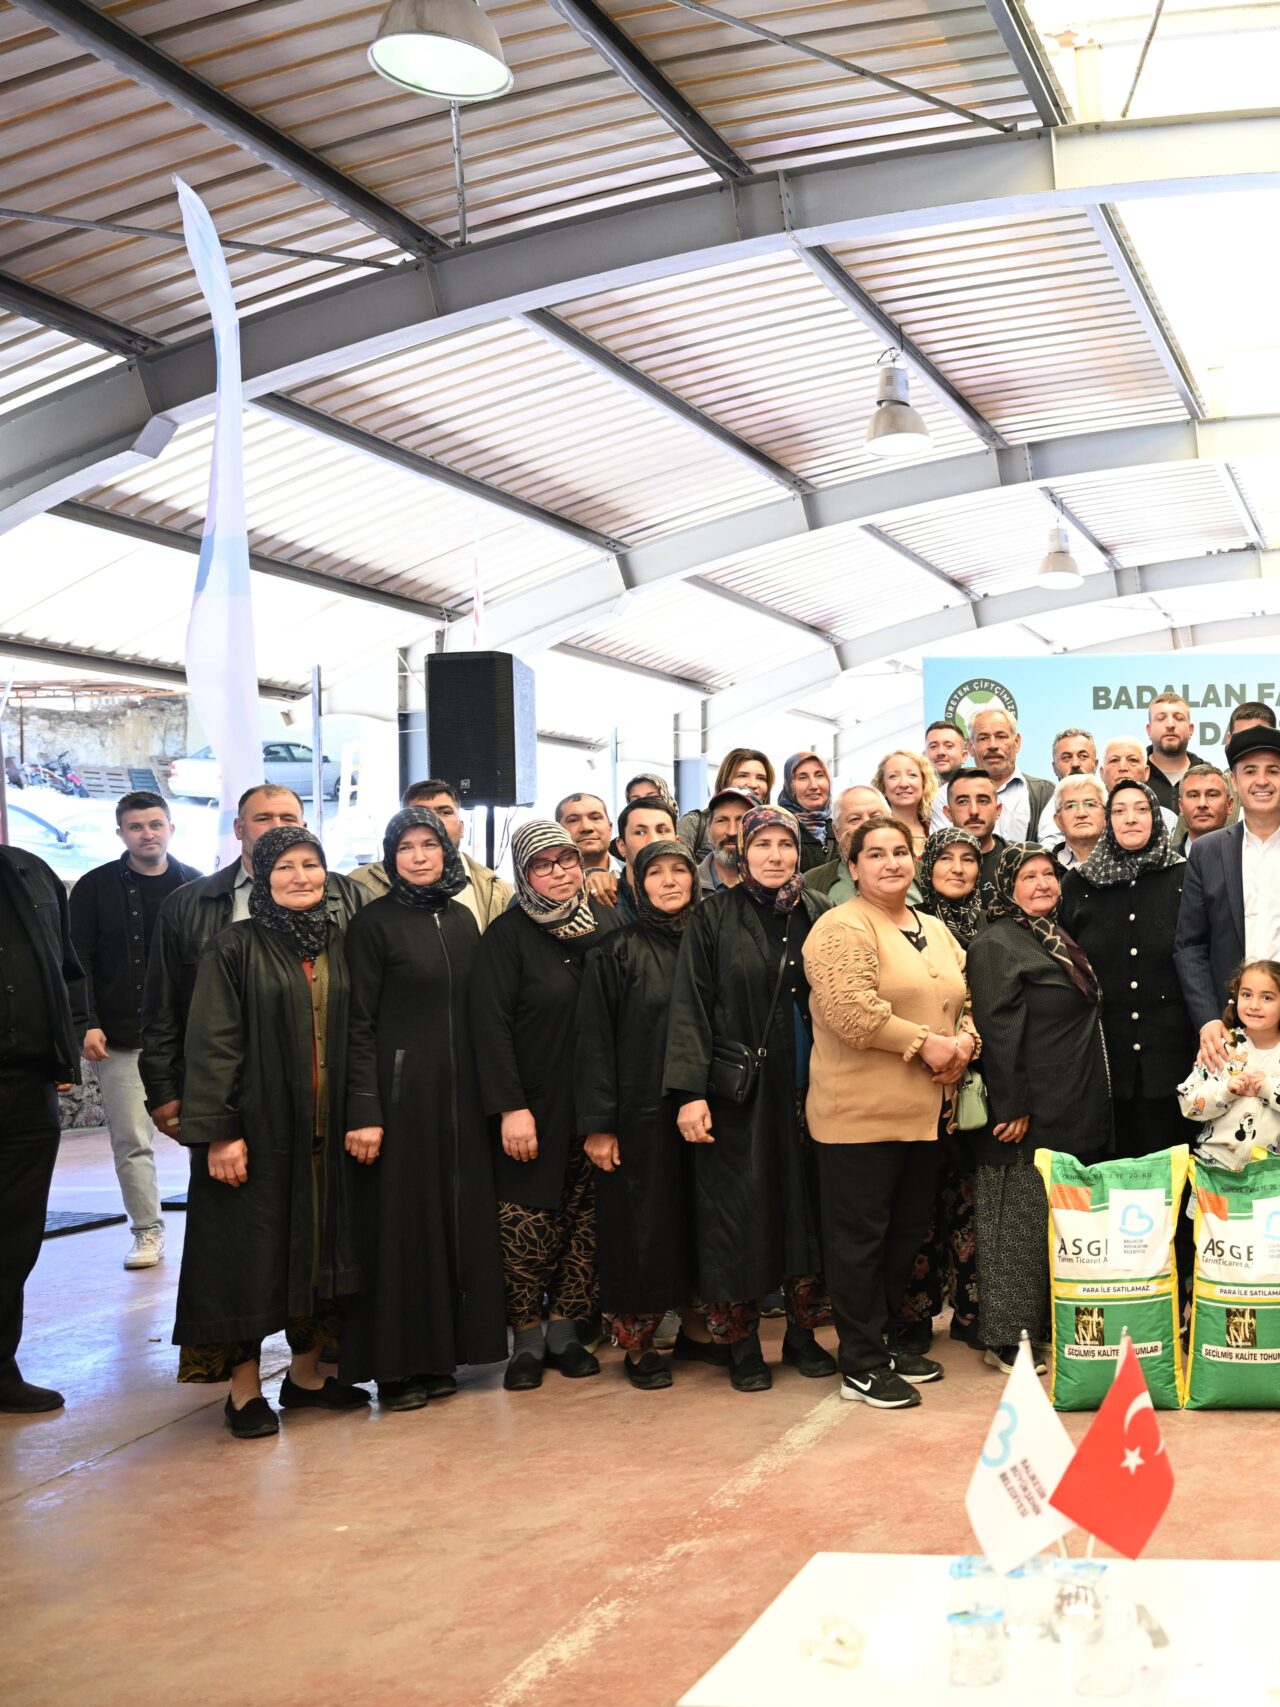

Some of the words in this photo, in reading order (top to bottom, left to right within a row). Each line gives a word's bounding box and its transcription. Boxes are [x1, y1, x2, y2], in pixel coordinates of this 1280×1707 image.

[945, 685, 970, 718] ÜRETEN
[1112, 1285, 1150, 1293] SATILAMAZ
[1219, 1288, 1237, 1296] PARA
[1237, 1288, 1248, 1296] İLE
[1067, 1347, 1096, 1358] SEÇİLMİŞ
[1097, 1346, 1119, 1357] KALİTE
[1135, 1345, 1159, 1356] UMLAR
[1204, 1348, 1234, 1360] SEÇİLMİŞ
[1235, 1350, 1258, 1361] KALİTE
